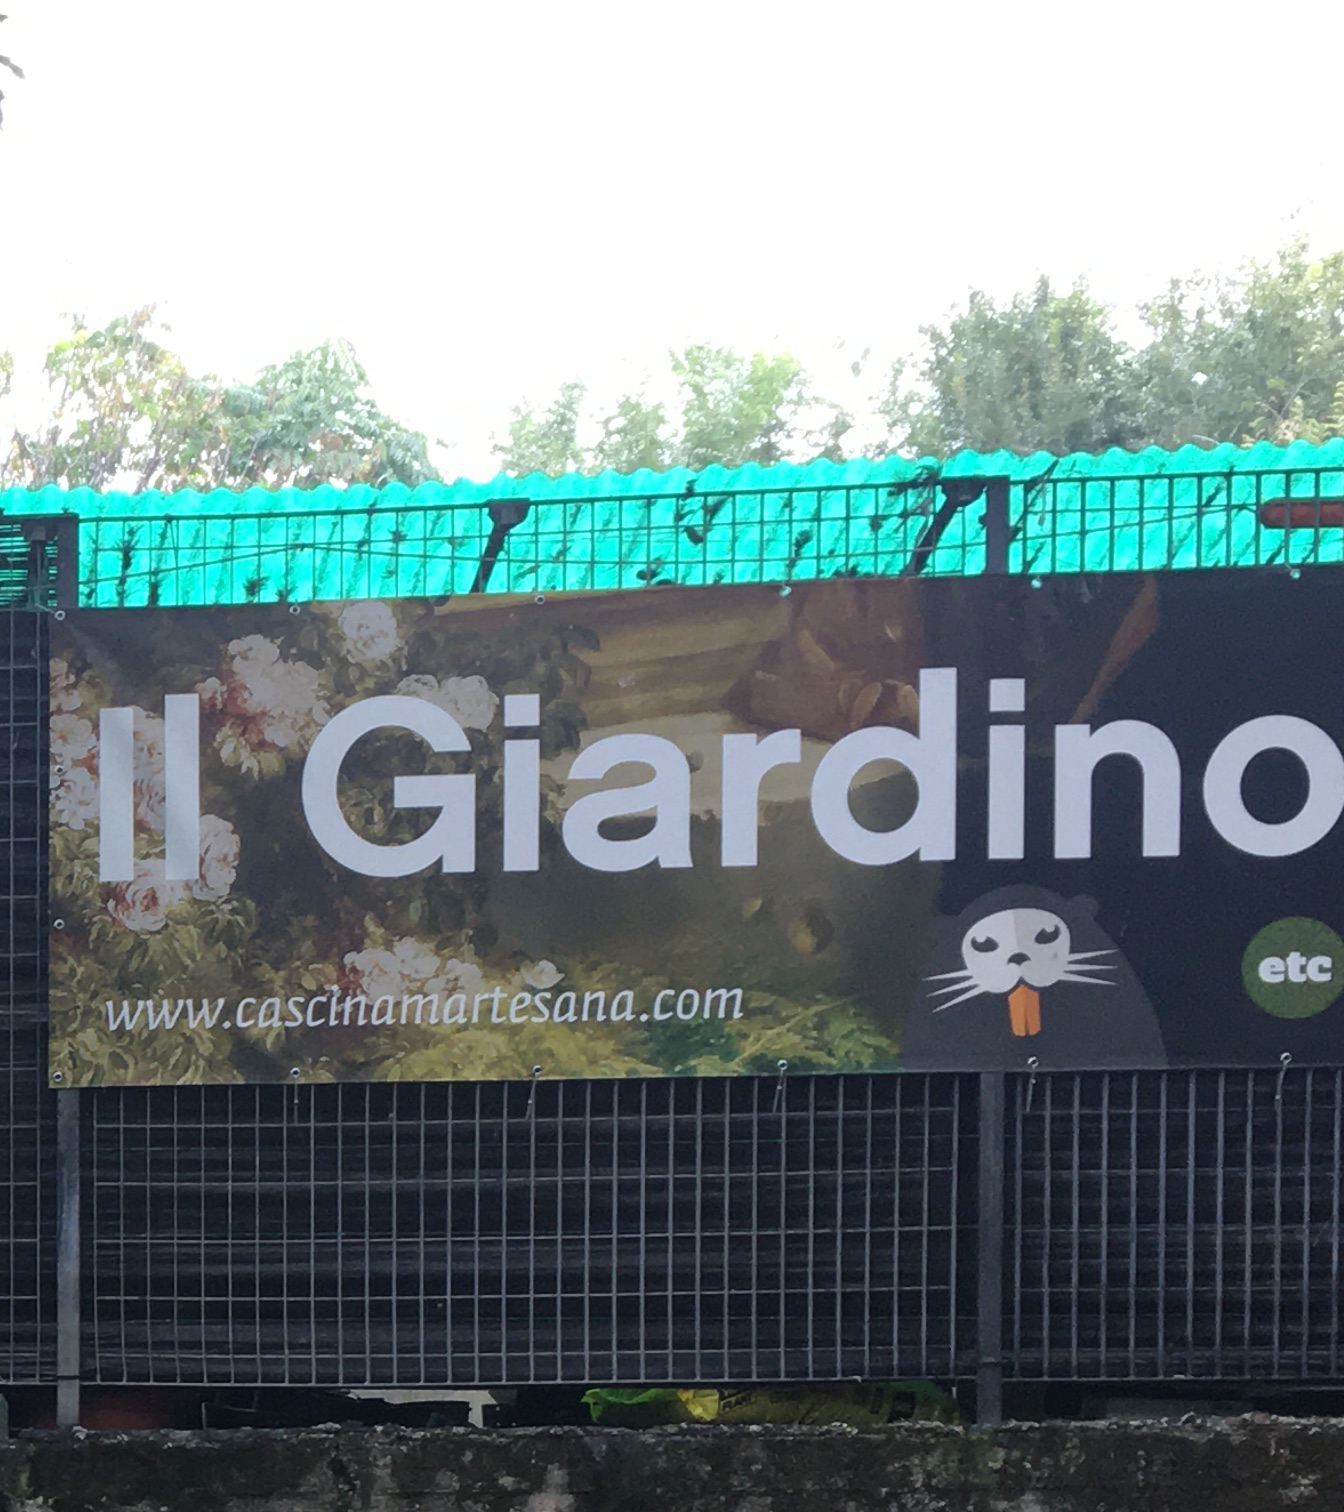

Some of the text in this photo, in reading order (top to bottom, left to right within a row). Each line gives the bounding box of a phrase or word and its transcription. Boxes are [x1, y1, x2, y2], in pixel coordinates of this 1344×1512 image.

[99, 667, 1344, 882] Il Giardino
[1258, 951, 1332, 984] etc
[105, 985, 745, 1031] www.cascinamartesana.com
